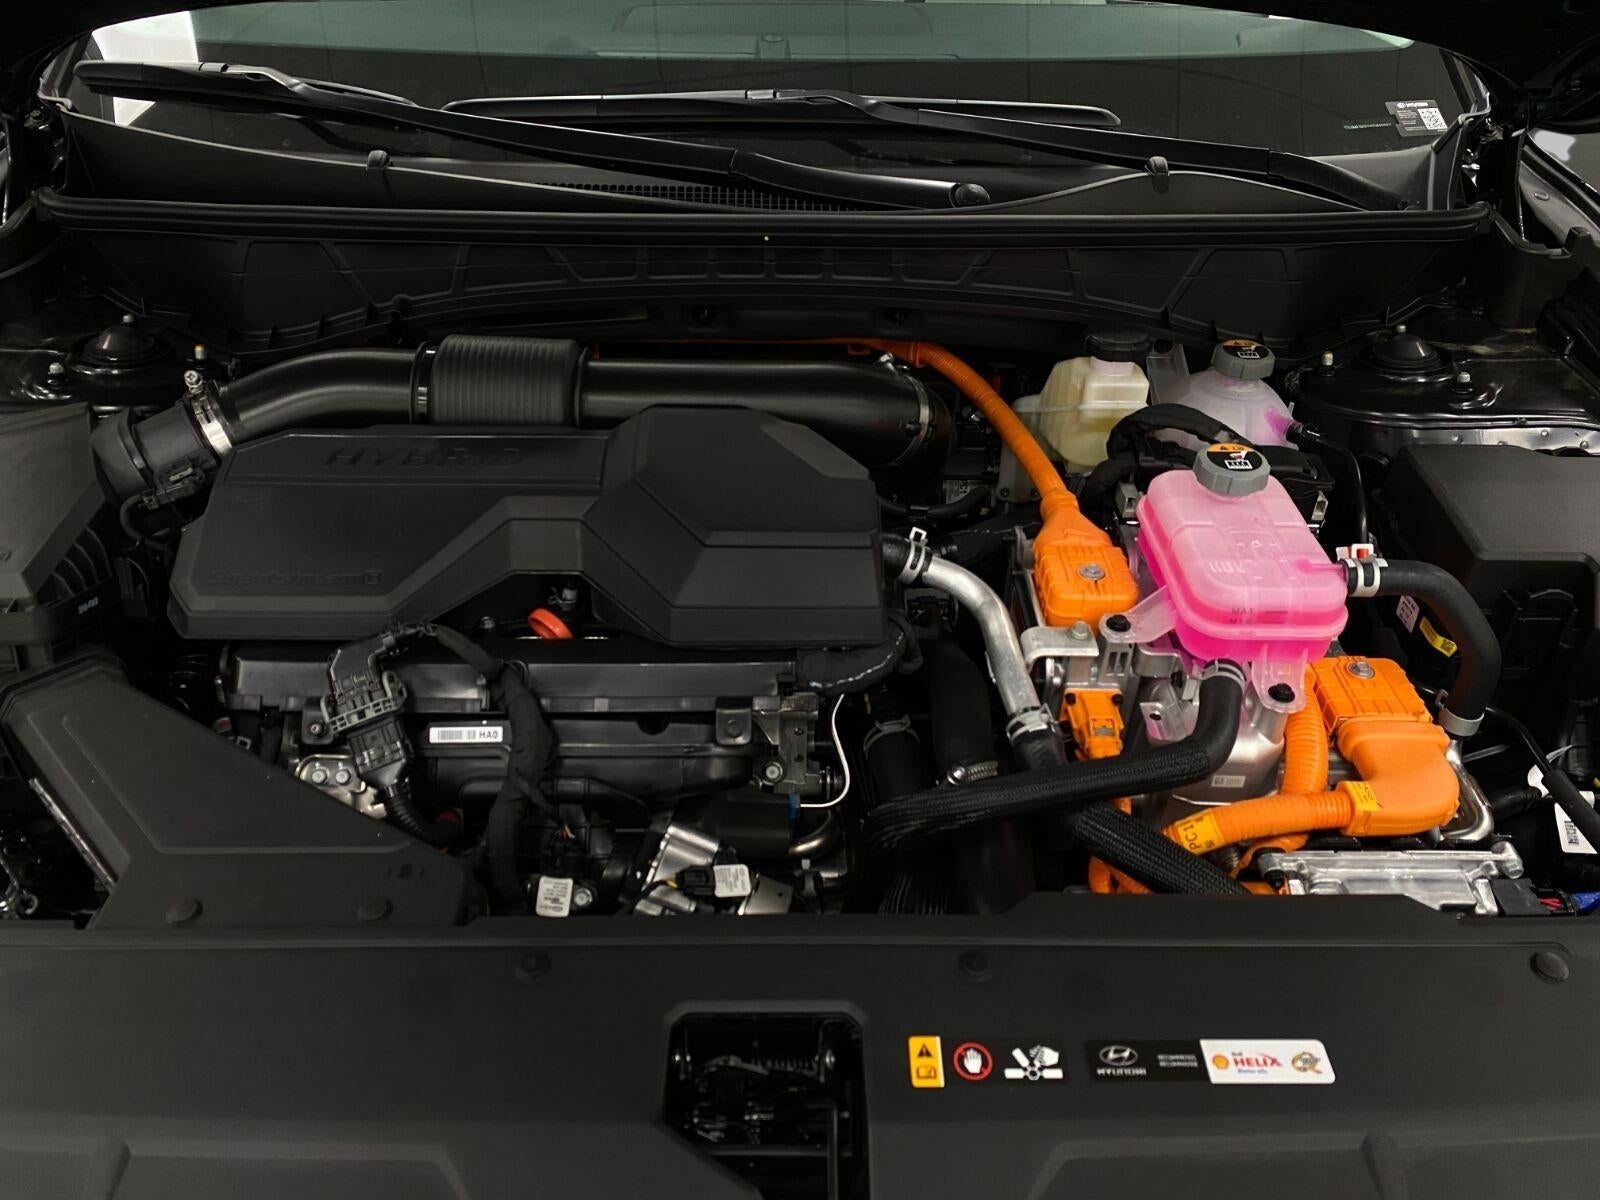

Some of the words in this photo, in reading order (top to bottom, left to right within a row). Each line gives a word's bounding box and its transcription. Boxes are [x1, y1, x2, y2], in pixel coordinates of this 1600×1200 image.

[322, 446, 521, 469] HYBRID
[207, 570, 359, 586] Smartstream
[1183, 824, 1202, 851] PC1
[1233, 1054, 1283, 1068] HELIX
